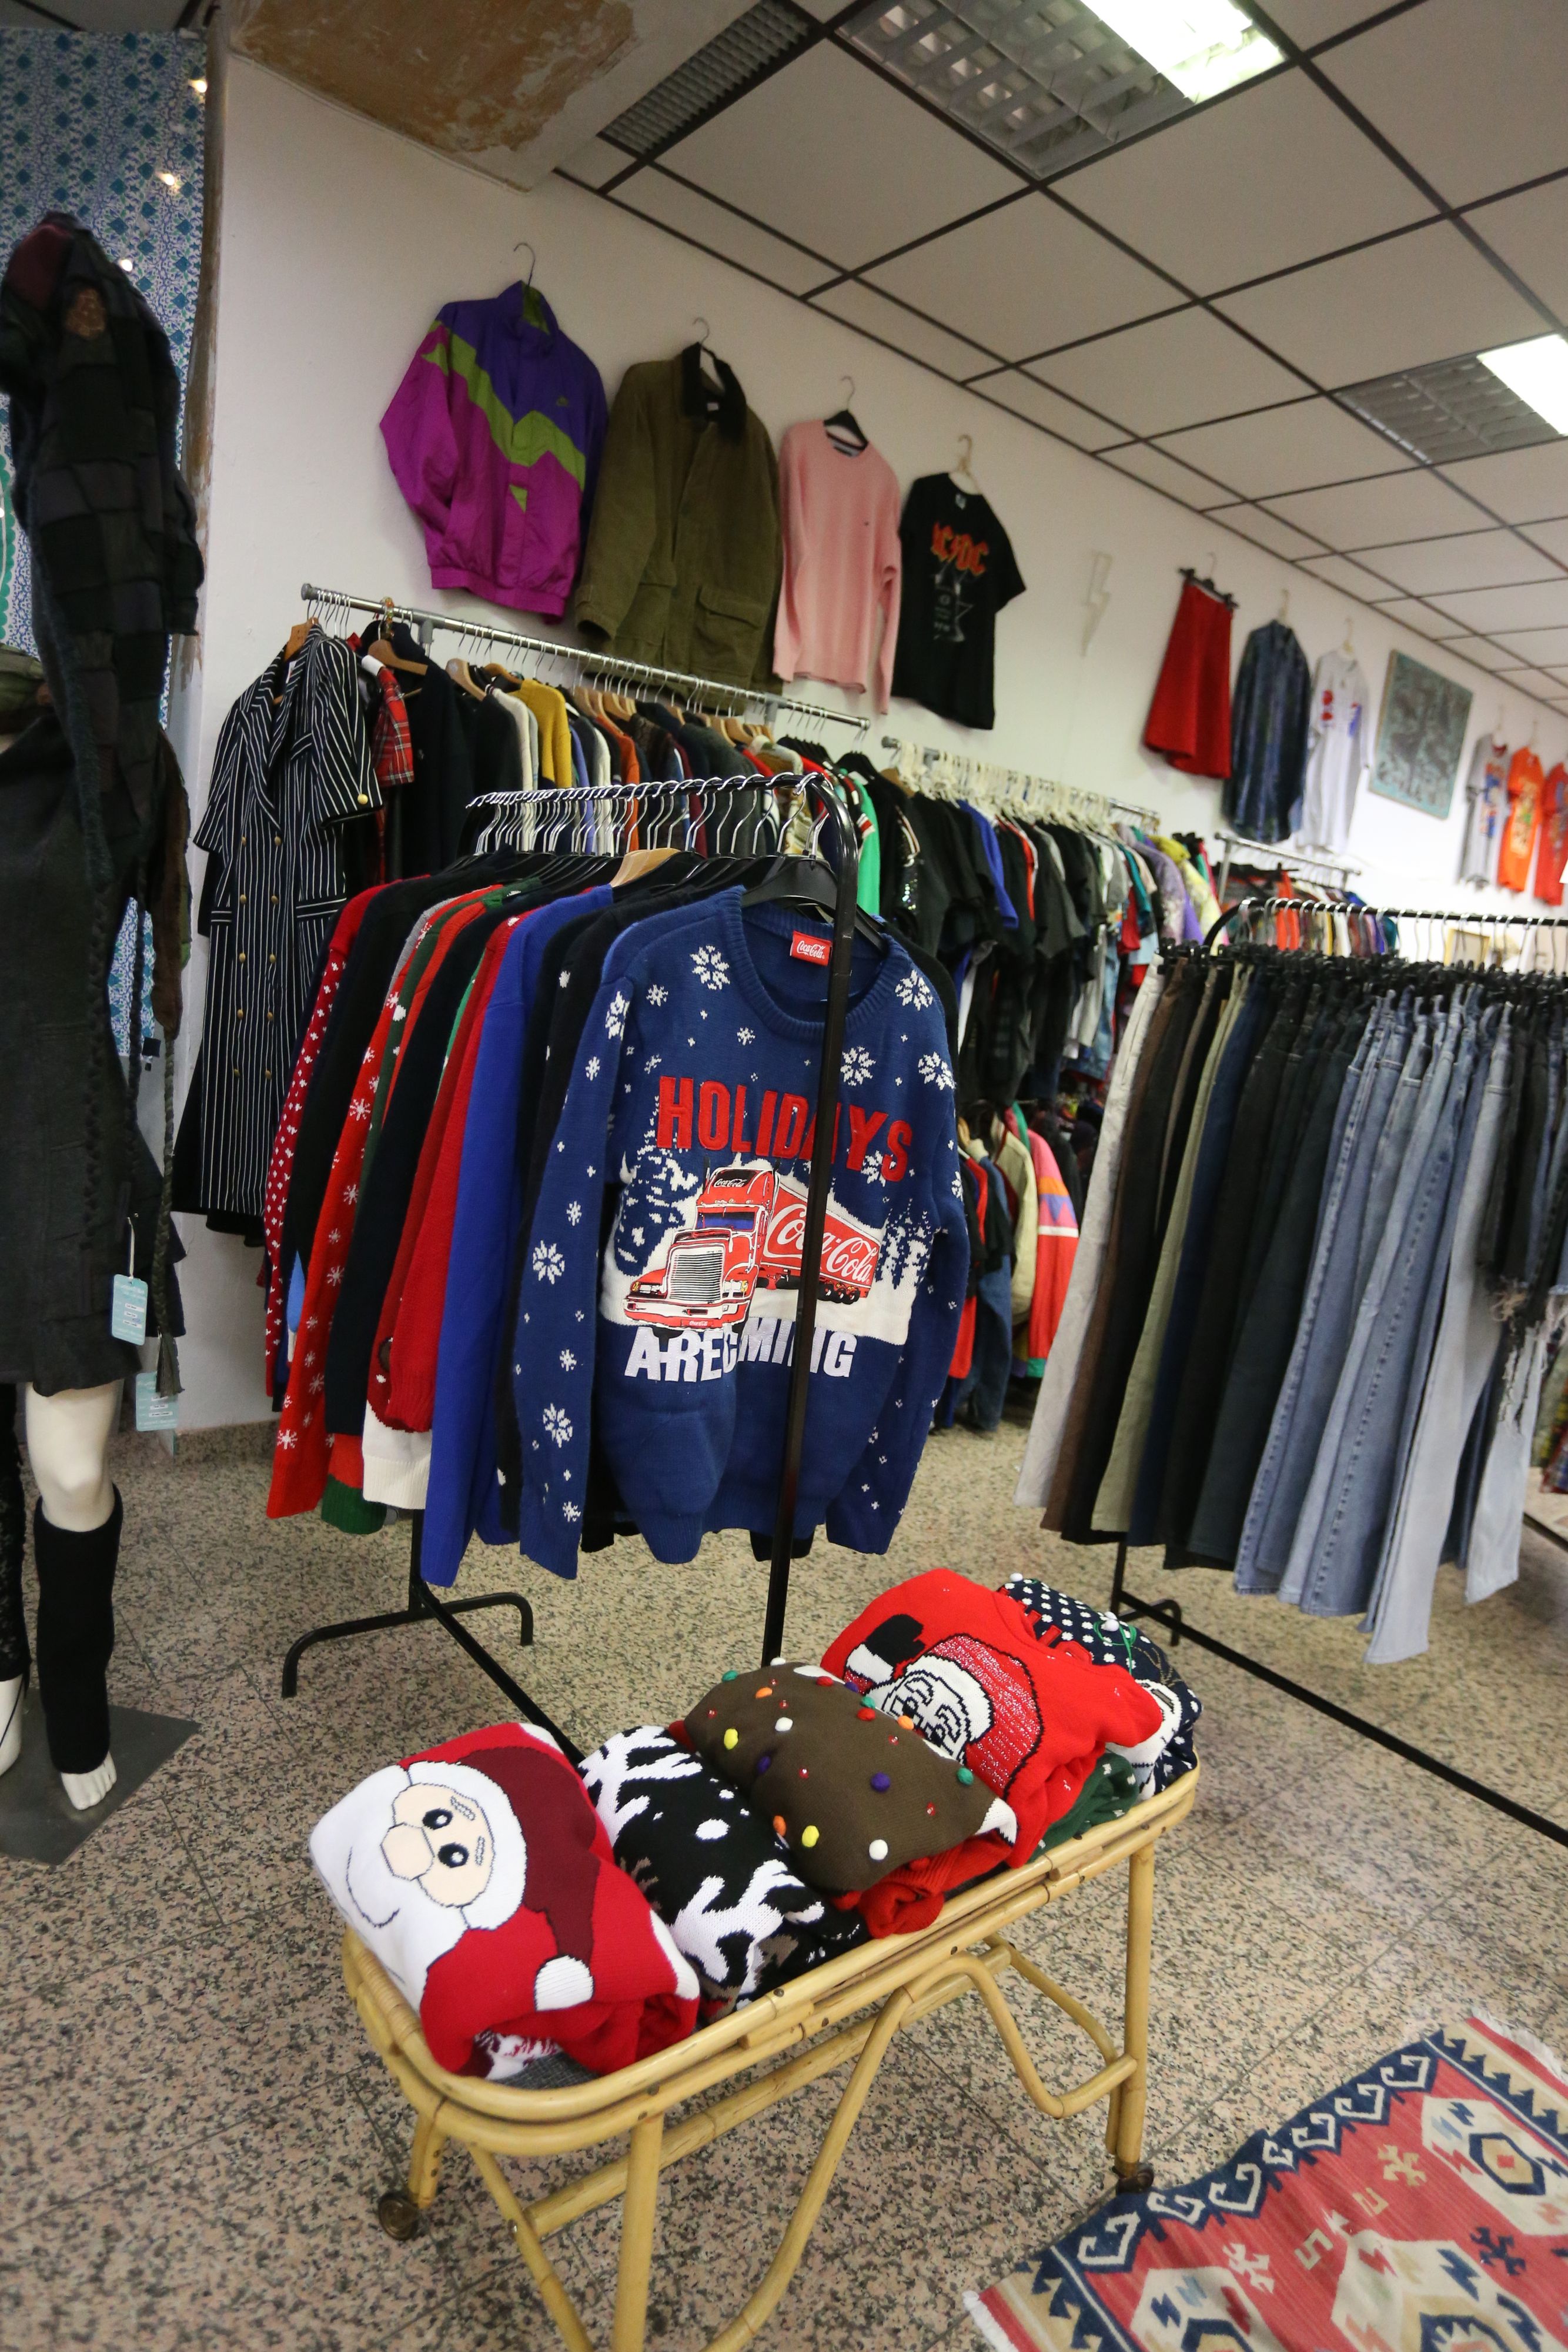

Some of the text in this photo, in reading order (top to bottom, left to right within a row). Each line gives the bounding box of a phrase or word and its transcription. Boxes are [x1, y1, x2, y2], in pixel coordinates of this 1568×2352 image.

[796, 940, 825, 959] Coca-Cola
[624, 1317, 857, 1382] ARE CMIG
